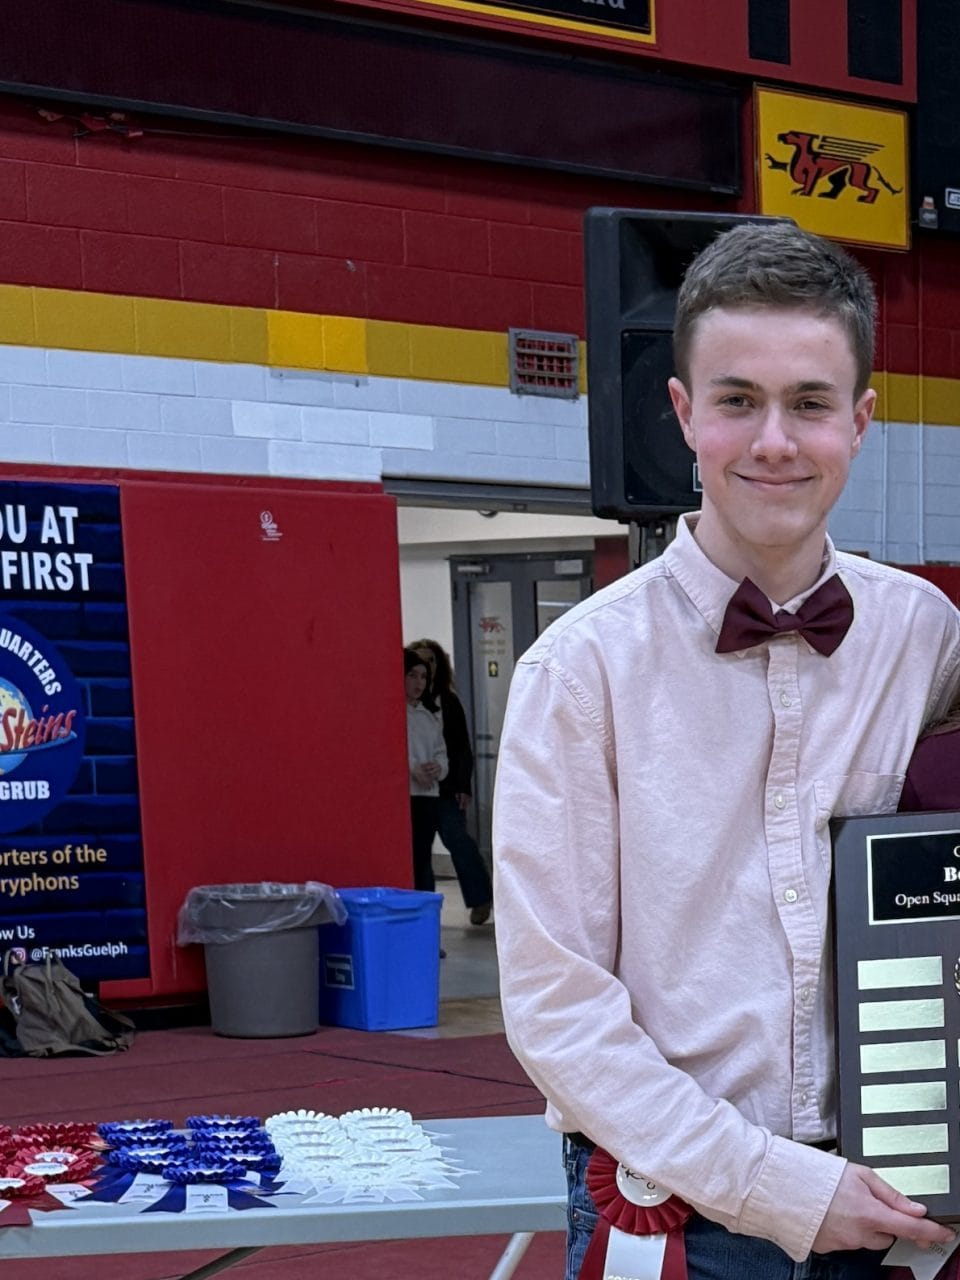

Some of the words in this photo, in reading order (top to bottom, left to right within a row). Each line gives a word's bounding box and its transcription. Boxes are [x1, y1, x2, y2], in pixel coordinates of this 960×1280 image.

[0, 504, 27, 544] U
[41, 505, 79, 545] AT
[1, 551, 93, 592] FIRST
[0, 780, 50, 800] GRUB
[0, 848, 48, 867] rters
[52, 844, 73, 864] of
[75, 843, 108, 864] the
[895, 893, 930, 908] Open
[17, 925, 36, 940] Us
